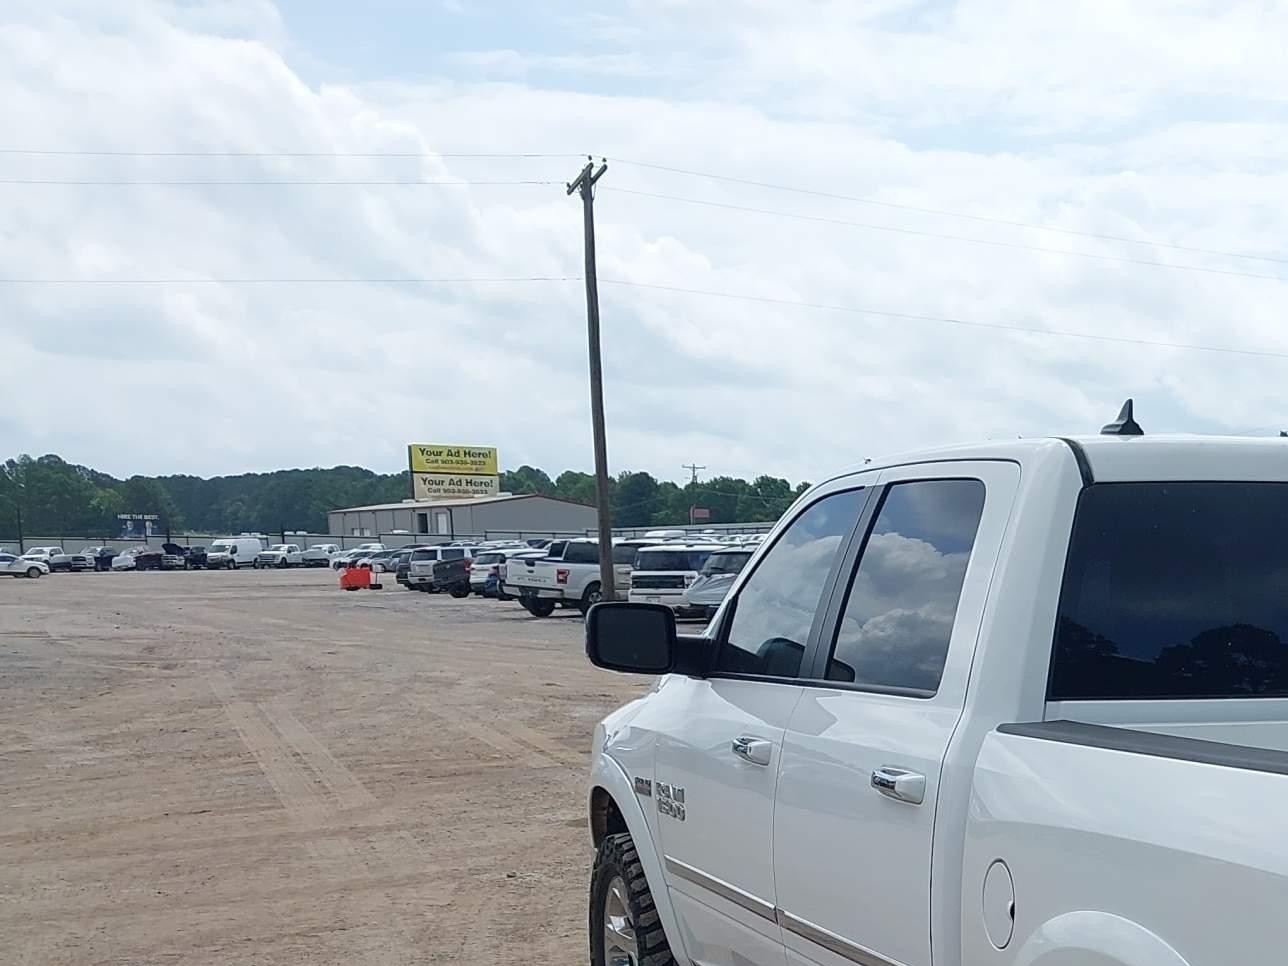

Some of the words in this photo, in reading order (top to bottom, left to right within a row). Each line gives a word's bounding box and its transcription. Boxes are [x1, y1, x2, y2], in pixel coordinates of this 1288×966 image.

[419, 447, 443, 457] Your
[446, 449, 460, 458] Ad
[463, 450, 492, 459] Here!
[421, 477, 445, 486] Your
[448, 478, 462, 487] Ad
[465, 479, 494, 488] Here!
